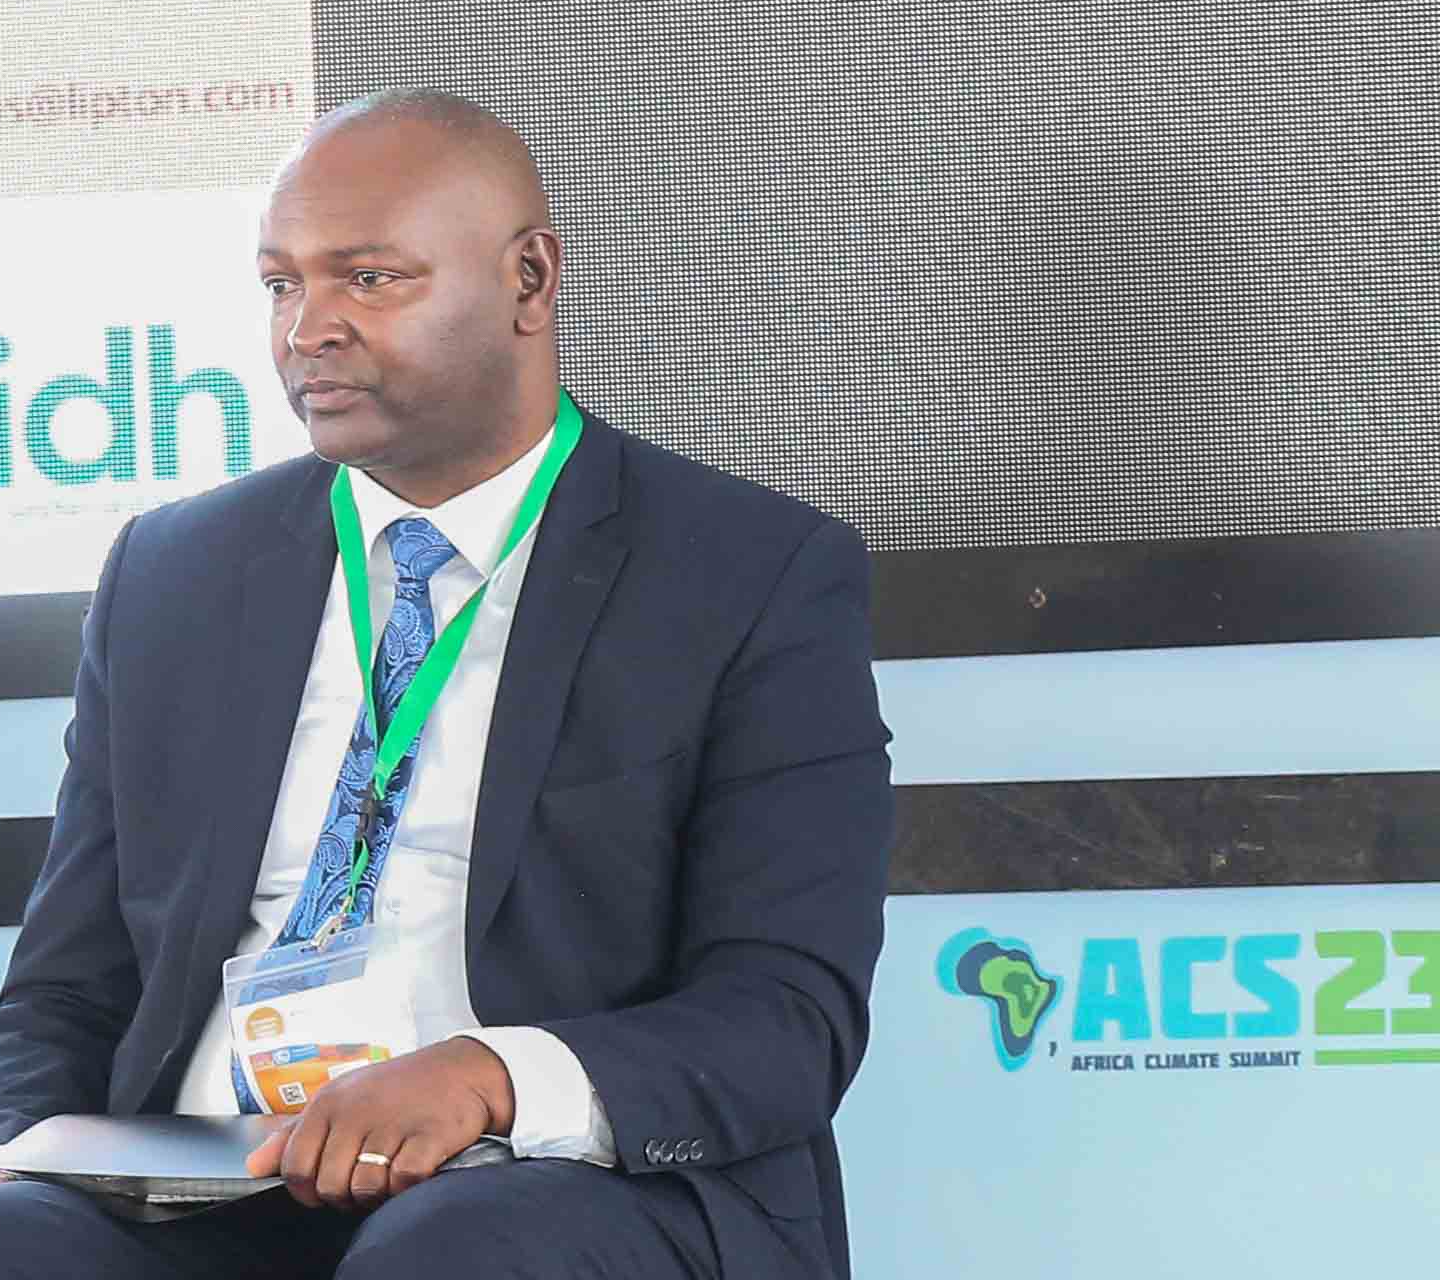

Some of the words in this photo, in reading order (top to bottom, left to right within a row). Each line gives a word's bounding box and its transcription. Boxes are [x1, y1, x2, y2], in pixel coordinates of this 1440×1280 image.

[1072, 929, 1440, 1041] ACS23
[1072, 1054, 1134, 1072] AFRICA
[1145, 1052, 1219, 1070] CLIMATE
[1229, 1050, 1301, 1068] SUMMIT
